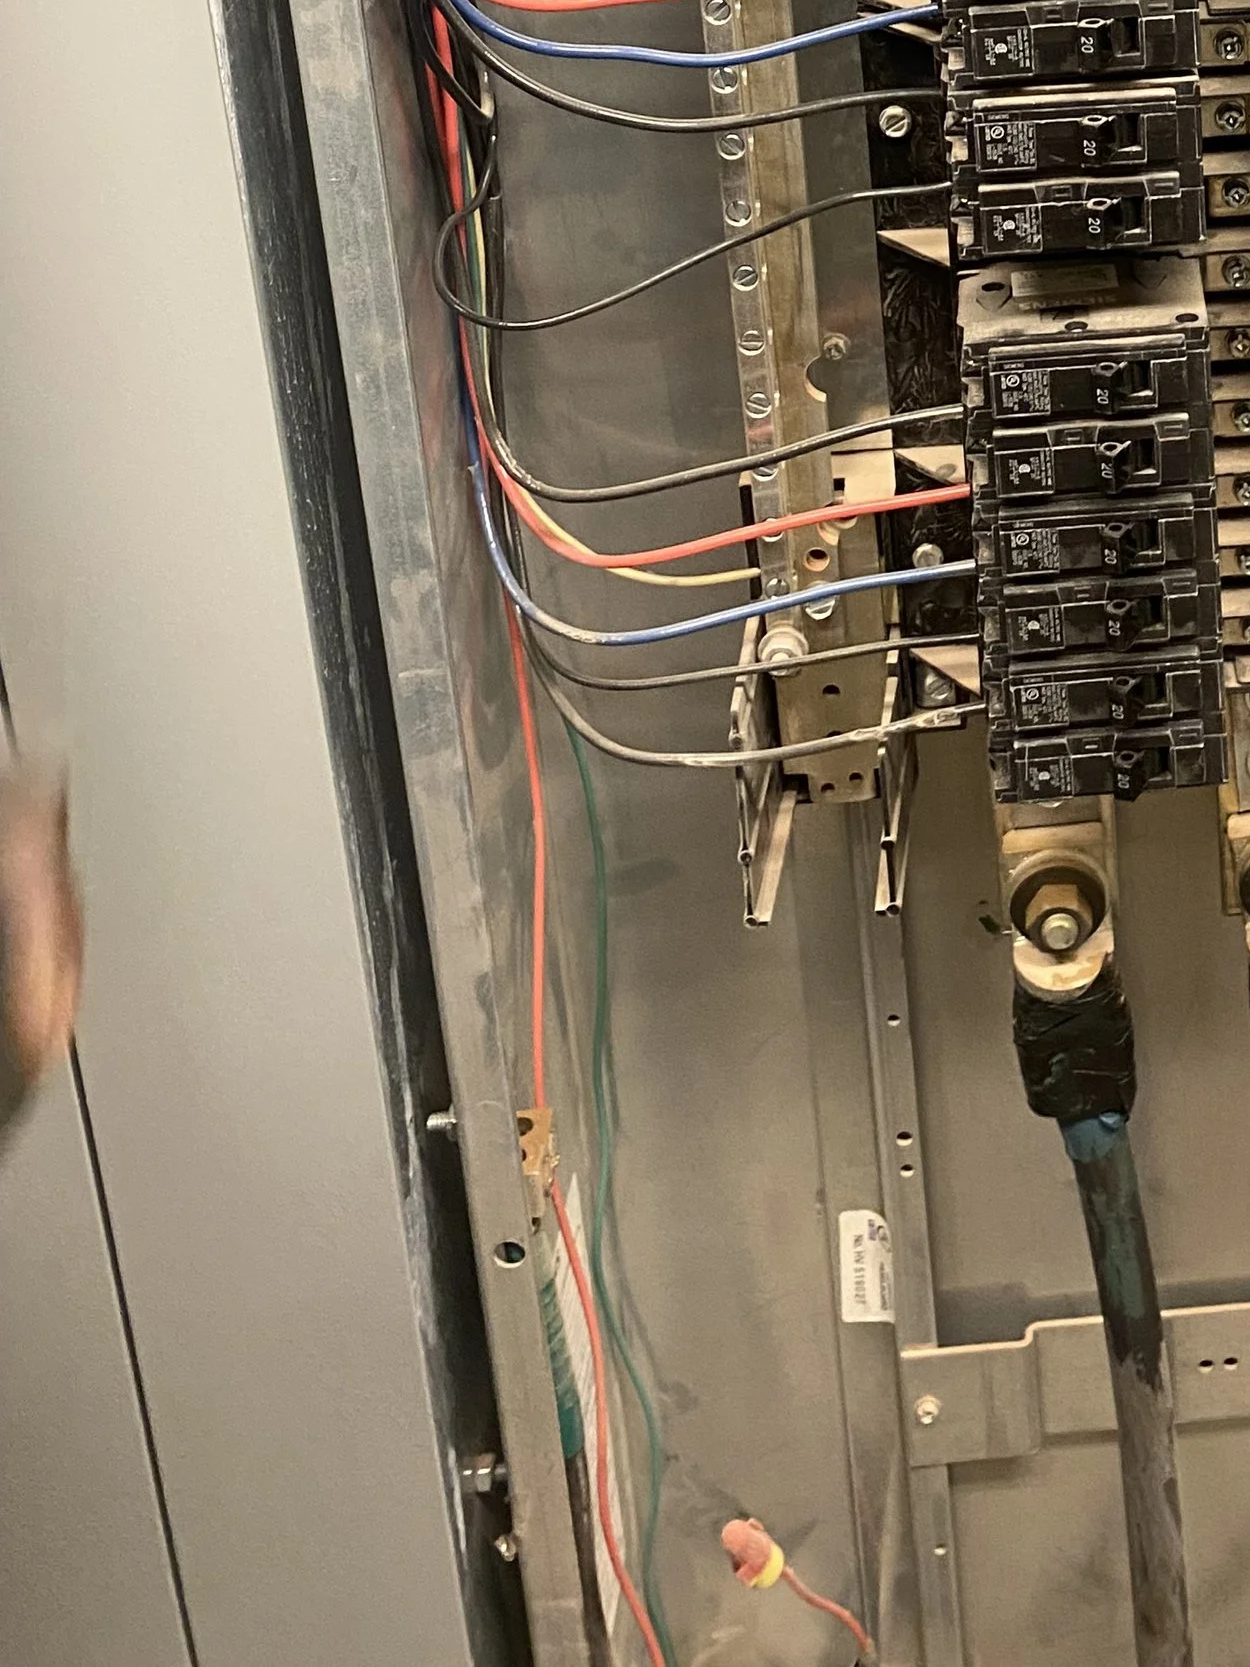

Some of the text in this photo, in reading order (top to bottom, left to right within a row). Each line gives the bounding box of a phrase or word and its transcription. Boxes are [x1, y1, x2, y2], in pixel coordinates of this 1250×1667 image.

[1081, 37, 1095, 54] 20
[1084, 140, 1097, 157] 20
[1089, 218, 1101, 234] 20
[1097, 389, 1109, 405] 20
